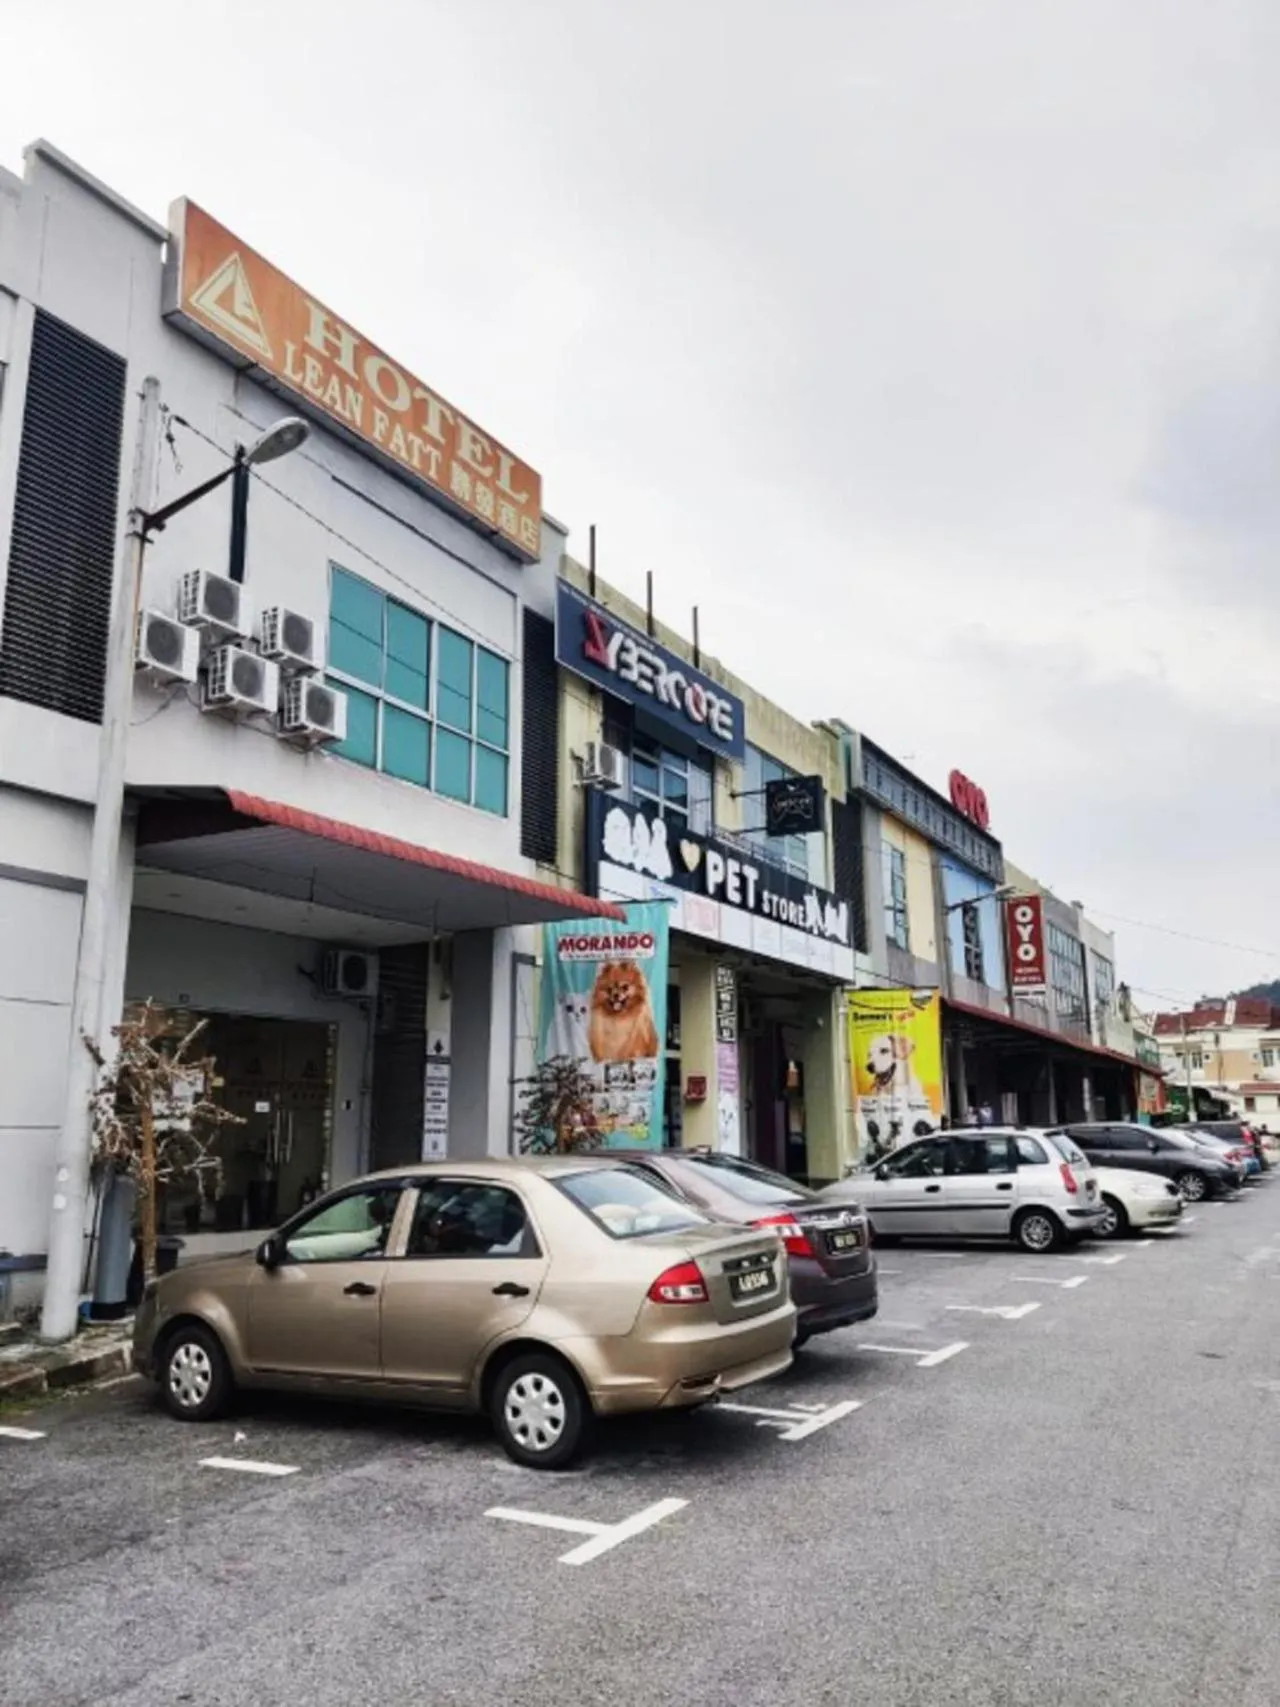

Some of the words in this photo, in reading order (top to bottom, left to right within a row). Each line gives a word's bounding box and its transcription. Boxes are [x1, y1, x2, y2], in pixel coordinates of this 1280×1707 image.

[282, 340, 364, 429] LEAN
[371, 406, 442, 480] FATT
[303, 299, 530, 504] HOTEL
[706, 849, 760, 909] PET
[762, 889, 805, 928] STORE
[557, 933, 654, 953] MORANDO
[1014, 904, 1037, 962] OYO
